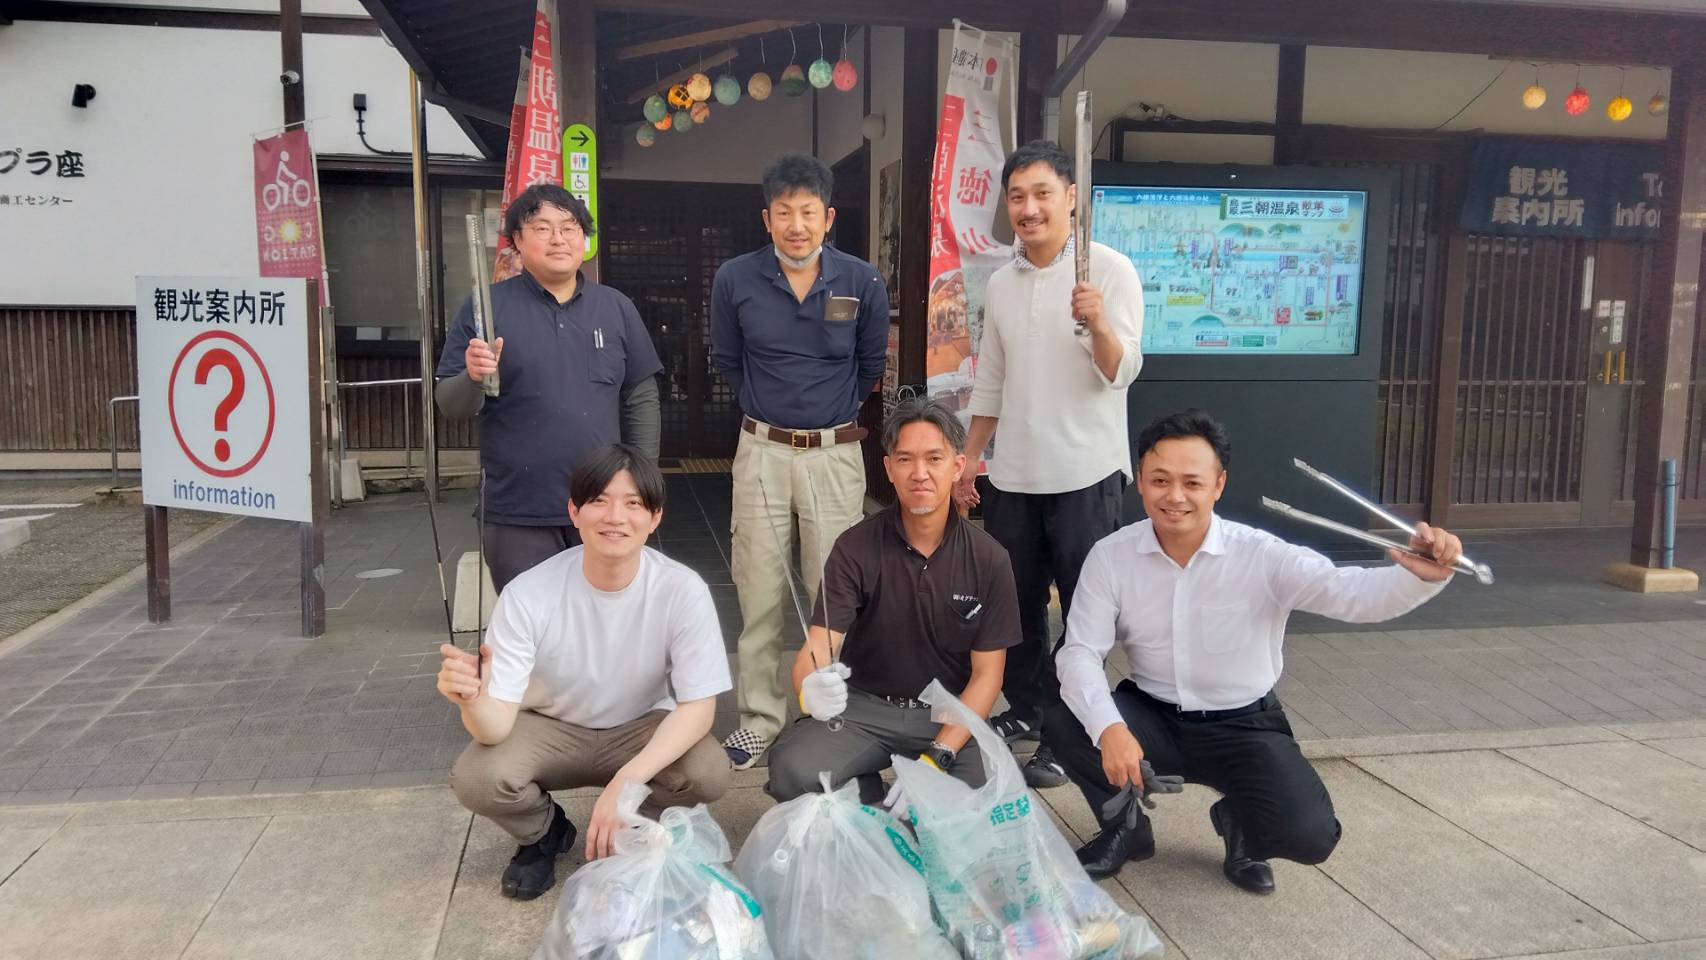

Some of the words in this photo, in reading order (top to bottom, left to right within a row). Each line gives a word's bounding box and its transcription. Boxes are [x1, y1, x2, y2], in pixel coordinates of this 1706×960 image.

[1508, 165, 1569, 196] 観光
[0, 194, 73, 206] 商工センター
[1240, 200, 1300, 216] 三朝温泉
[1491, 197, 1585, 227] 案内所
[153, 287, 286, 327] 観光案内所
[172, 479, 276, 510] information
